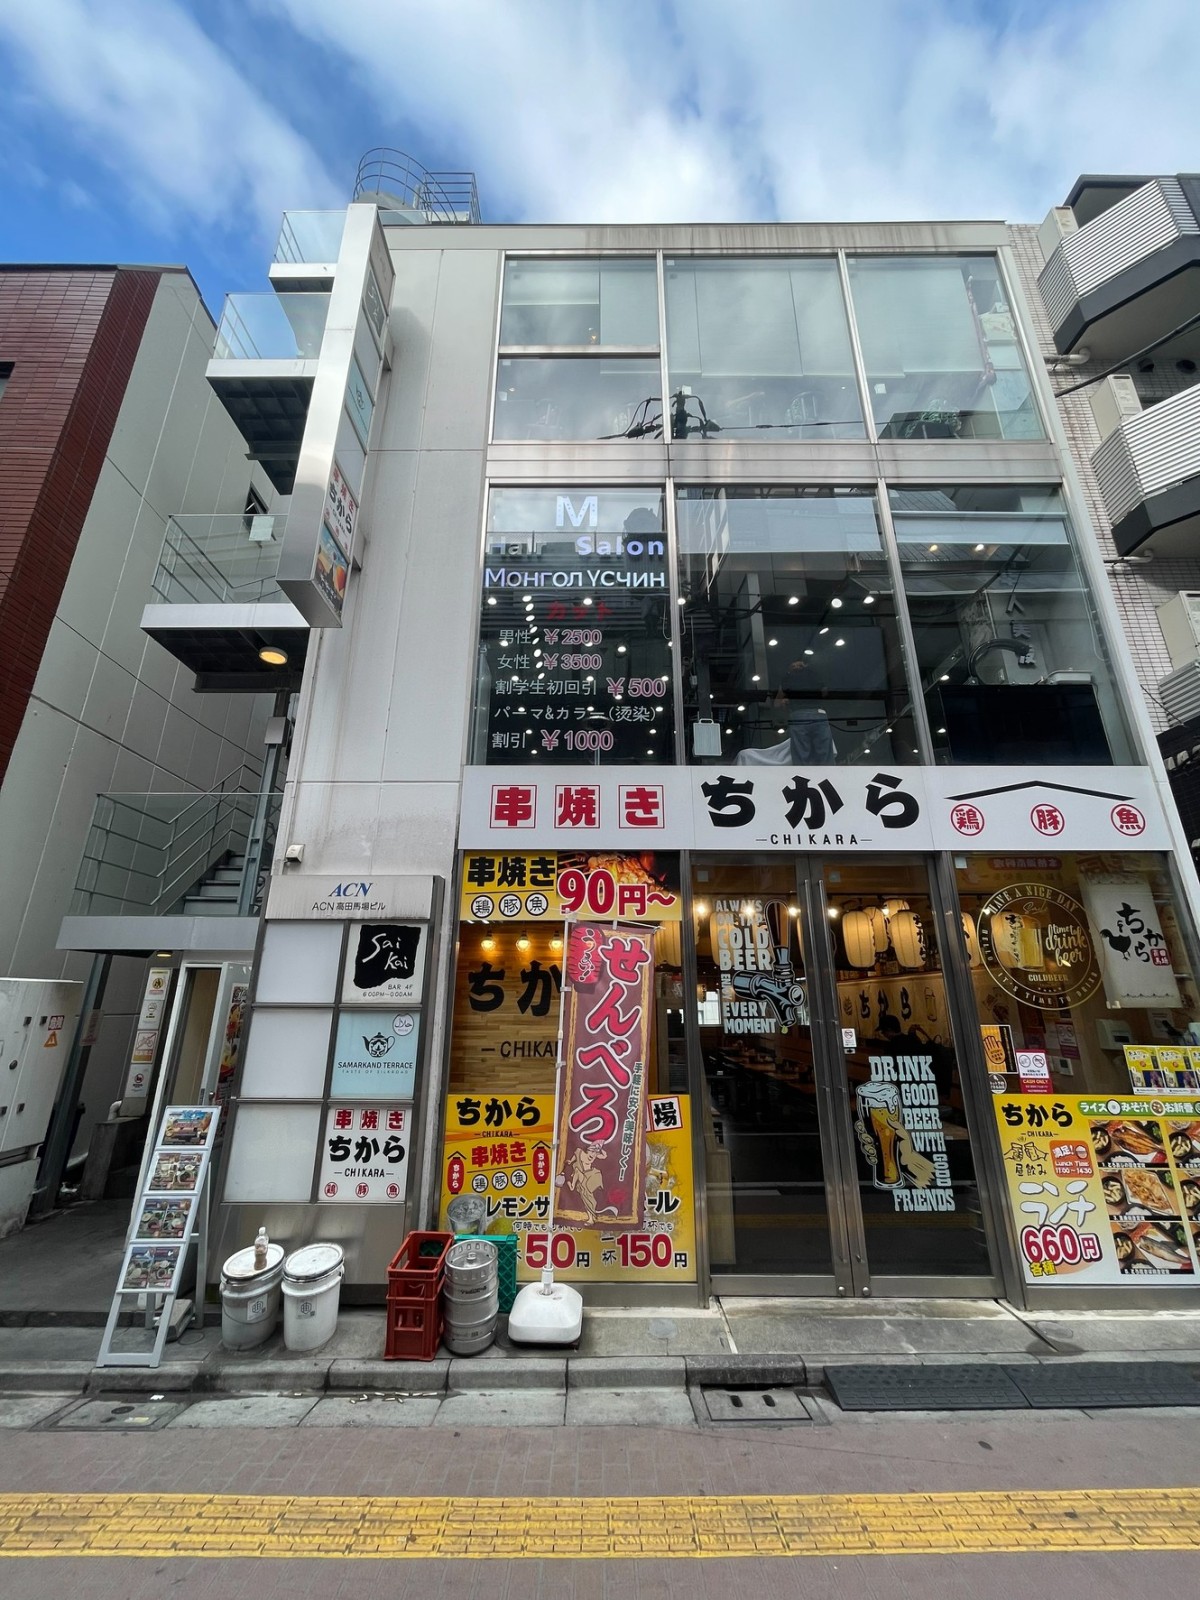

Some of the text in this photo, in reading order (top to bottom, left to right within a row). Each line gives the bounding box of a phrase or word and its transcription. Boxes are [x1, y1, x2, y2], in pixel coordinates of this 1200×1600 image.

[555, 495, 598, 527] M
[575, 536, 664, 556] Salon
[499, 629, 531, 644] 男性
[497, 654, 530, 670] 女性
[495, 679, 598, 696] 割学生初回引
[491, 732, 526, 749] 割引
[701, 773, 919, 830] ちから
[770, 834, 858, 845] CHIKARA
[467, 856, 555, 887] 串焼き
[328, 882, 374, 897] ACN
[1025, 885, 1053, 899] NICE
[1057, 894, 1079, 912] DAY
[718, 927, 769, 949] COLD
[1116, 902, 1164, 963] ちから
[719, 949, 773, 971] BEER
[1055, 949, 1083, 967] beer
[723, 1002, 767, 1017] EVERY
[724, 1018, 776, 1034] MOMENT
[501, 1041, 558, 1058] CHIKA
[568, 936, 652, 1145] せんべろ
[337, 1061, 382, 1069] SAMARKAND
[868, 1056, 935, 1082] DRINK
[901, 1083, 939, 1106] GOOD
[456, 1096, 541, 1127] ちから
[653, 1101, 677, 1128] 場
[902, 1107, 942, 1130] BEER
[1001, 1103, 1073, 1128] ちから
[1079, 1102, 1108, 1113] ライス
[1121, 1102, 1150, 1113] みそ汁
[482, 1130, 513, 1138] CHIKARA
[911, 1132, 947, 1152] WITH
[328, 1135, 406, 1164] ちから
[471, 1141, 527, 1168] 串焼き
[344, 1167, 385, 1178] CHIKARA
[933, 1153, 952, 1187] GOOD
[893, 1188, 955, 1212] FRIENDS
[1021, 1224, 1103, 1265] 660円
